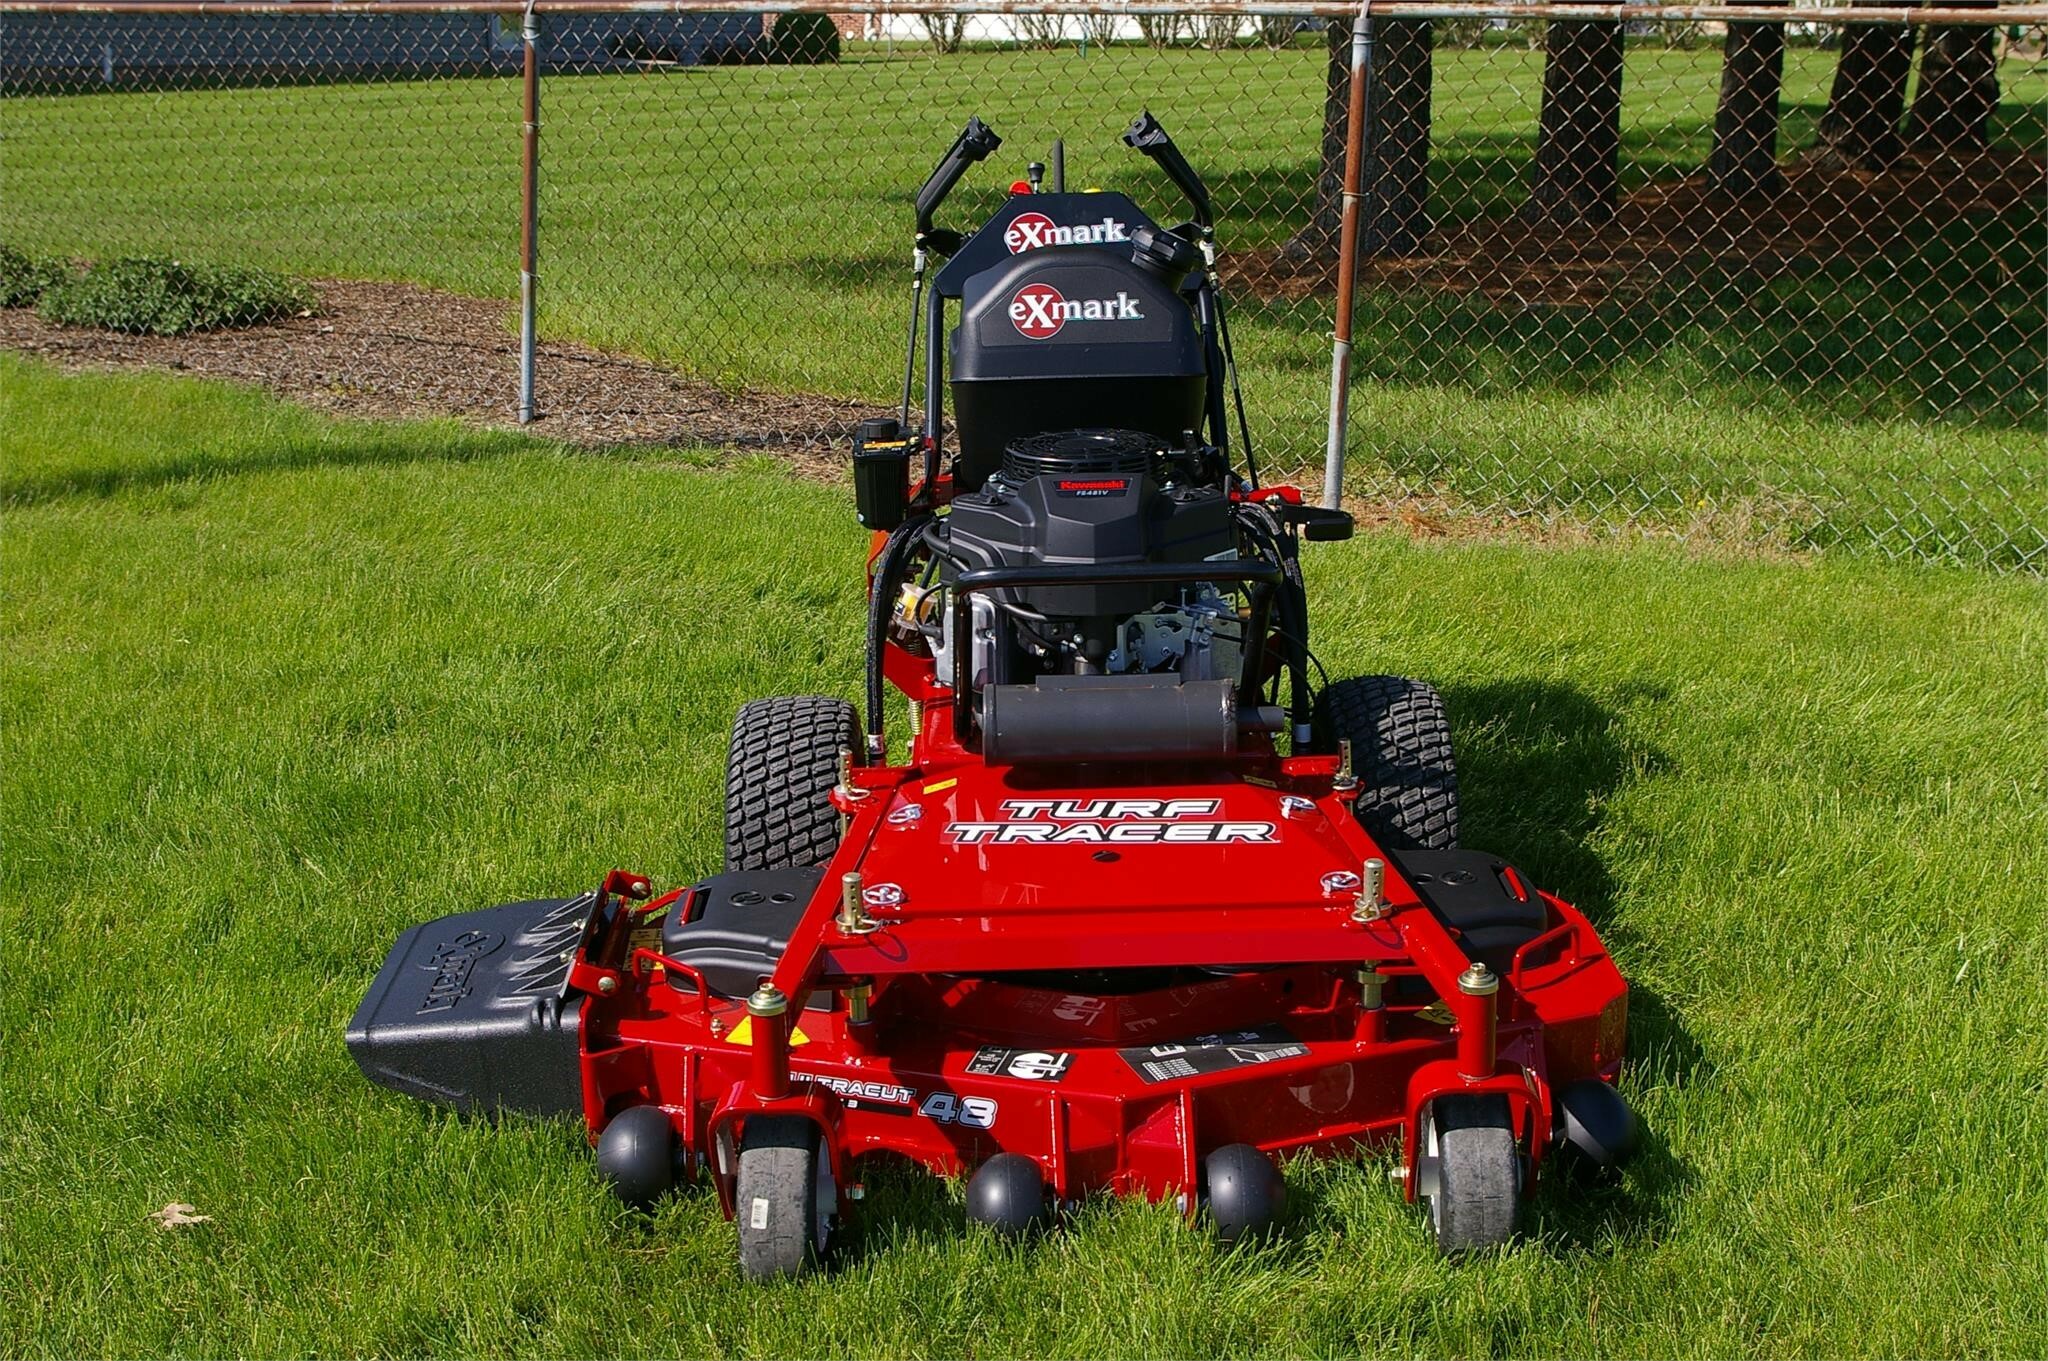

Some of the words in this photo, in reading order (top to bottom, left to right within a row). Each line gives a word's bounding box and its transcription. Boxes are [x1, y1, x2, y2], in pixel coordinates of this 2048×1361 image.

[1004, 217, 1126, 253] eXmark
[1008, 291, 1140, 328] eXmark
[1060, 480, 1125, 489] Kawasaki
[1000, 799, 1223, 820] TURF
[944, 821, 1278, 843] TRACER
[918, 1091, 998, 1129] 48
